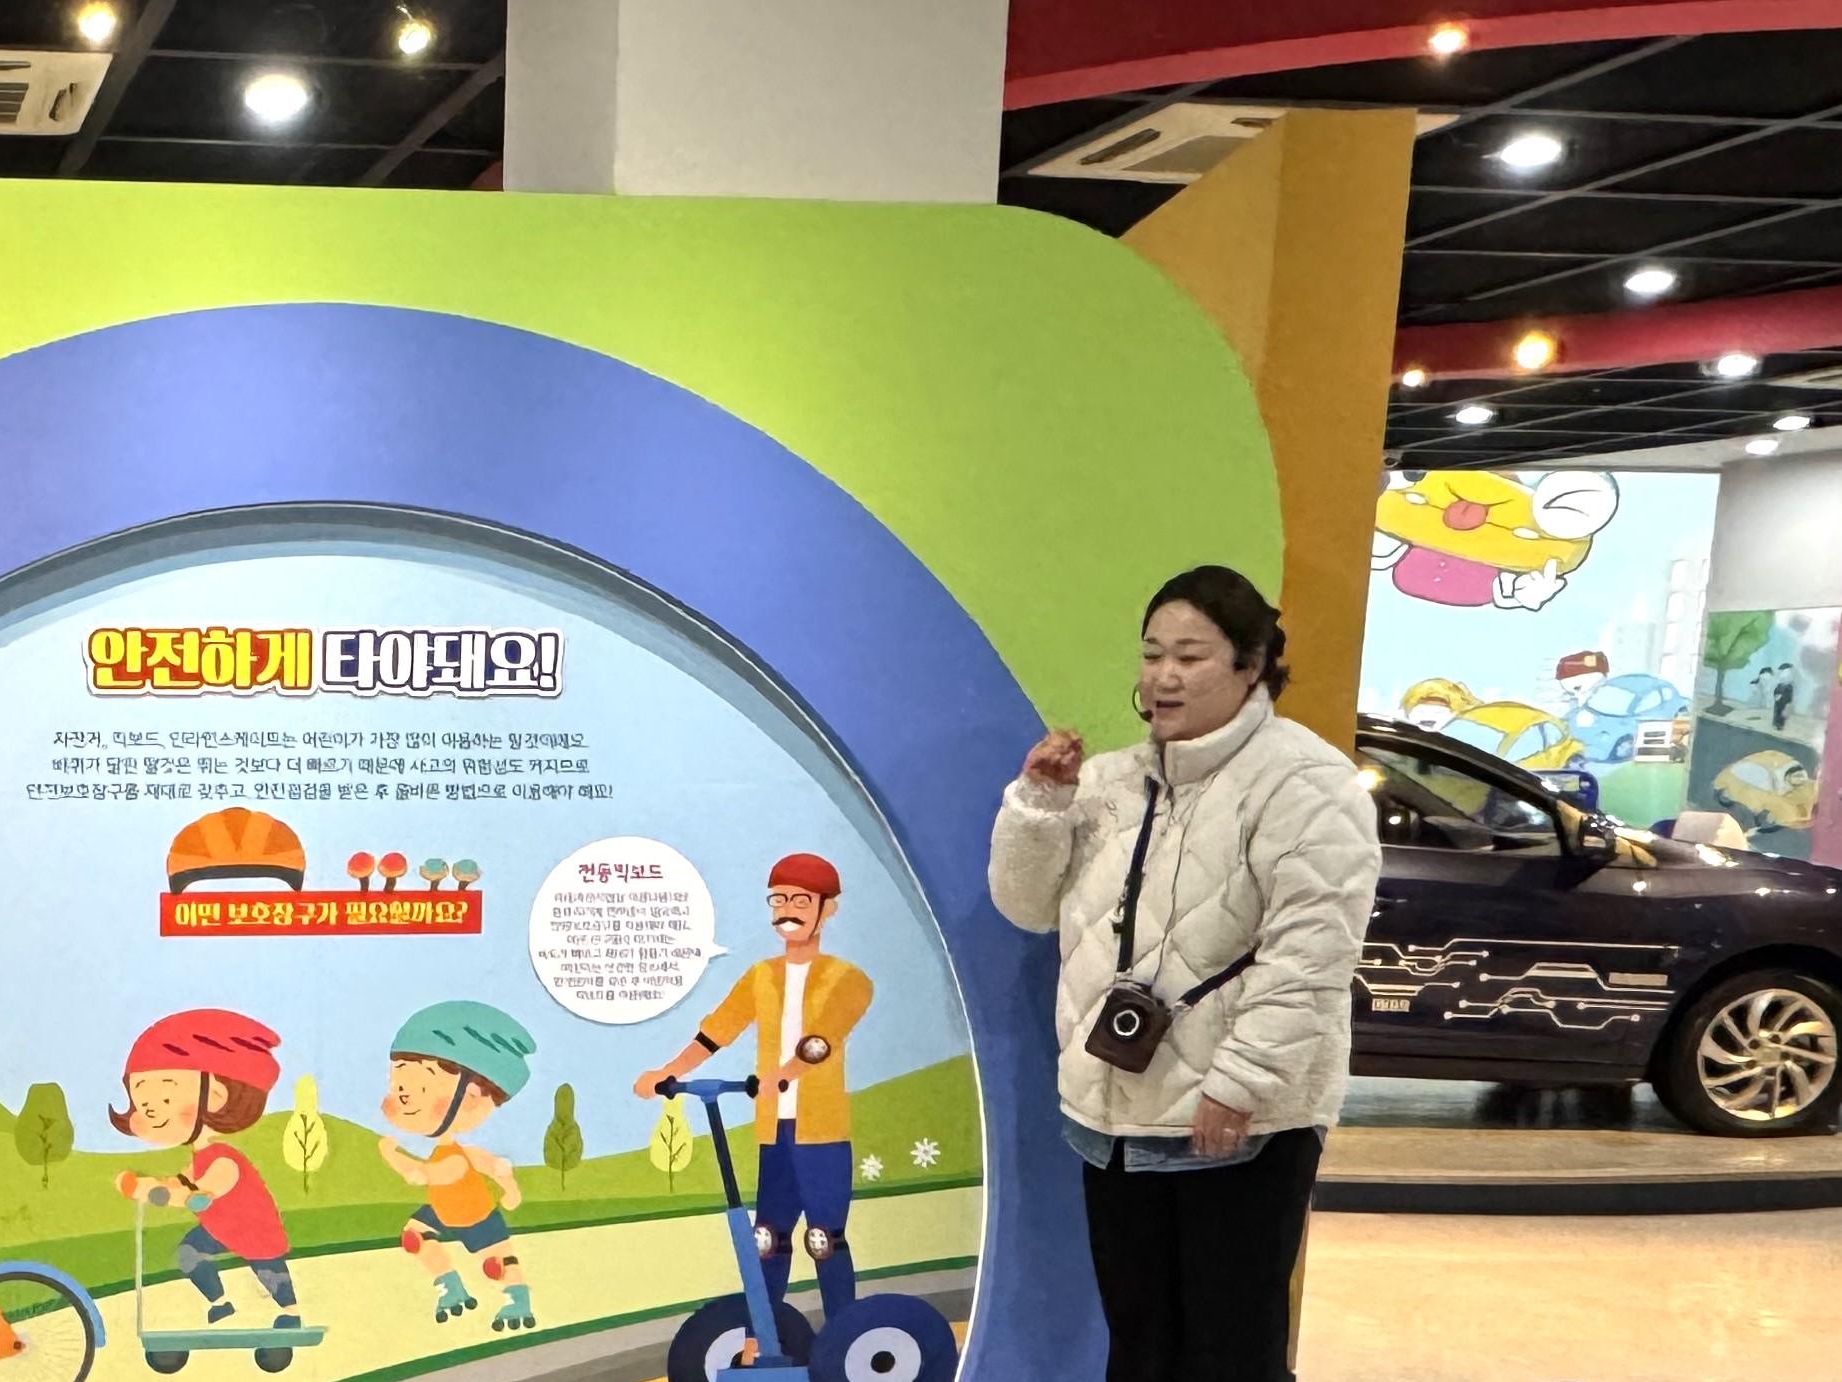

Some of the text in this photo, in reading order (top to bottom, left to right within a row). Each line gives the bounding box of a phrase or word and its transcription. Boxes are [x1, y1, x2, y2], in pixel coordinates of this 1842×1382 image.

[90, 630, 557, 690] 안전하게 타야돼요!
[302, 731, 364, 749] 어린이가
[370, 731, 400, 750] 가장
[406, 731, 436, 750] 많이
[441, 731, 503, 751] 이용하는
[52, 756, 100, 776] 바퀴가
[234, 756, 282, 776] 것보다
[286, 756, 302, 776] 더
[306, 756, 354, 776] 빠르기
[358, 756, 406, 776] 때문에
[410, 757, 456, 776] 사고의
[462, 757, 525, 776] 위험성도
[529, 758, 591, 776] 커지므로
[26, 782, 140, 802] 안전보호장구를
[197, 782, 247, 801] 갖추고
[253, 782, 332, 802] 안전점검을
[338, 782, 369, 801] 받은
[374, 783, 390, 801] 후
[395, 782, 441, 802] 올바른
[445, 782, 508, 802] 방법으로
[512, 782, 574, 802] 이용해야
[578, 862, 664, 884] 전동킥보드
[226, 900, 339, 926] 보호장구가
[345, 900, 470, 926] 필요할까요?
